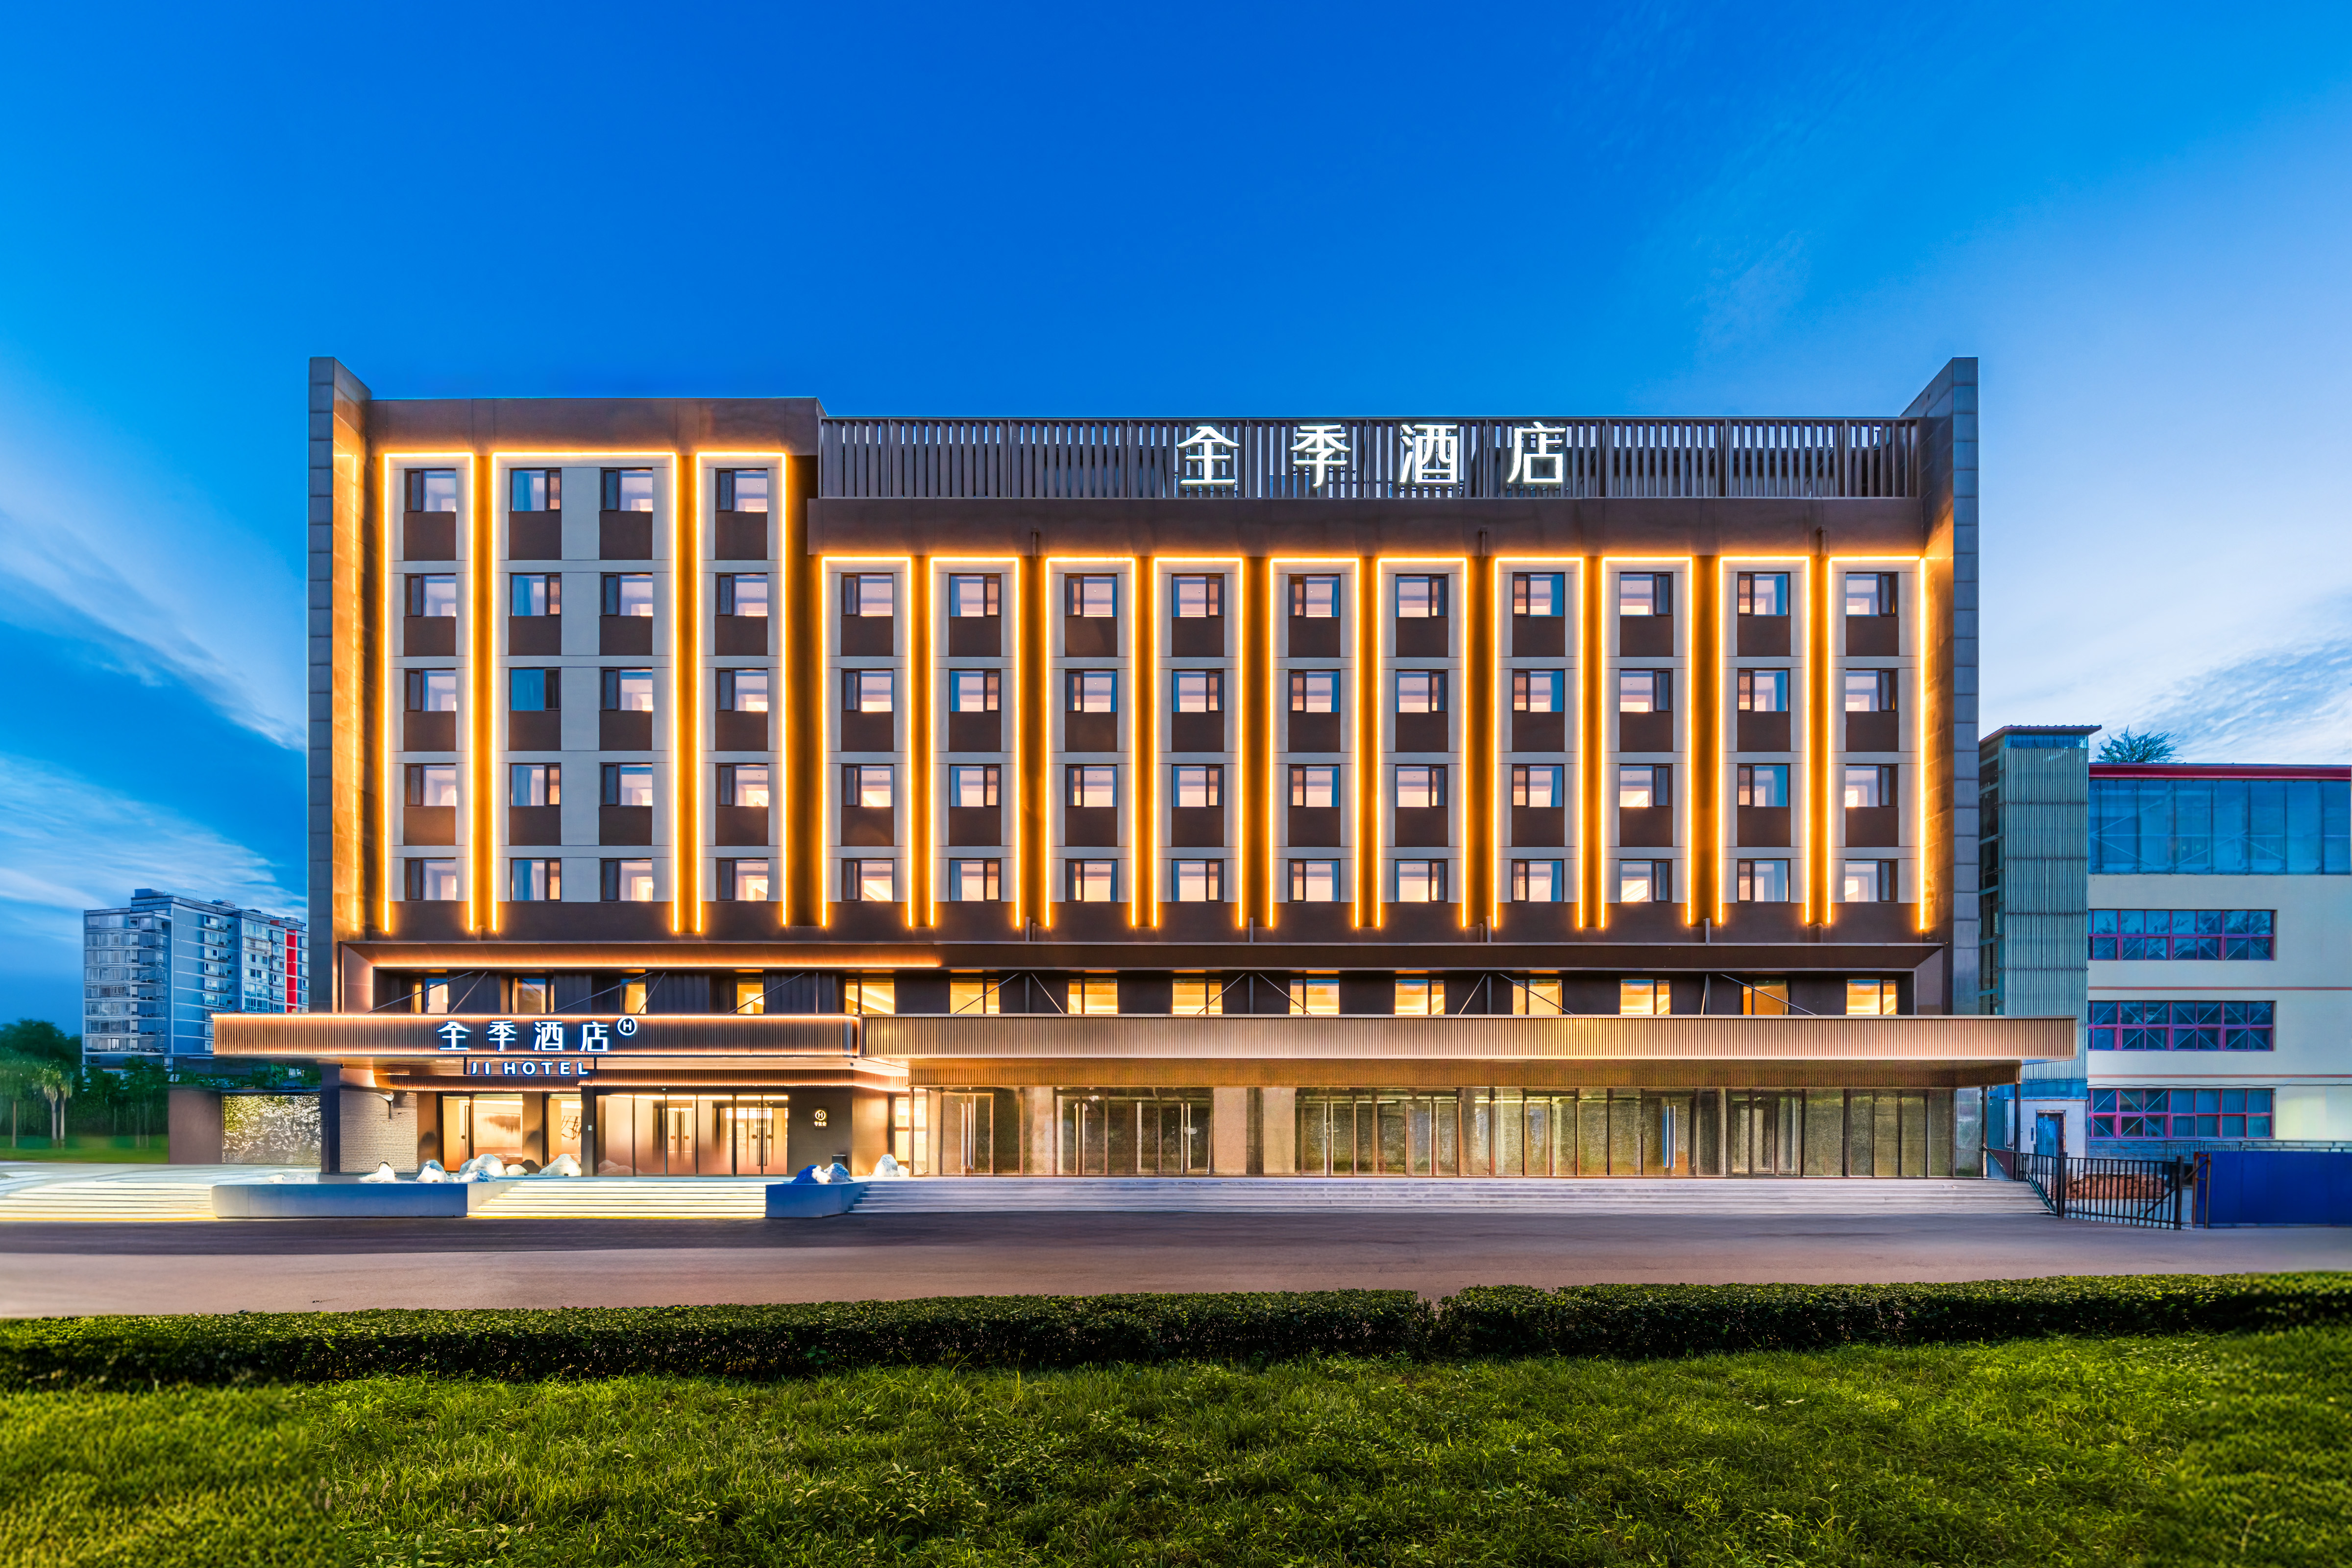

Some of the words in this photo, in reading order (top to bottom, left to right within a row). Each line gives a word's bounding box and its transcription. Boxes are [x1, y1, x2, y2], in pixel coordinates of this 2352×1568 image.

[1176, 421, 1566, 487] 全季酒店
[437, 1021, 609, 1052] 全季酒店
[472, 1062, 490, 1075] JI
[504, 1062, 588, 1075] HOTEL
